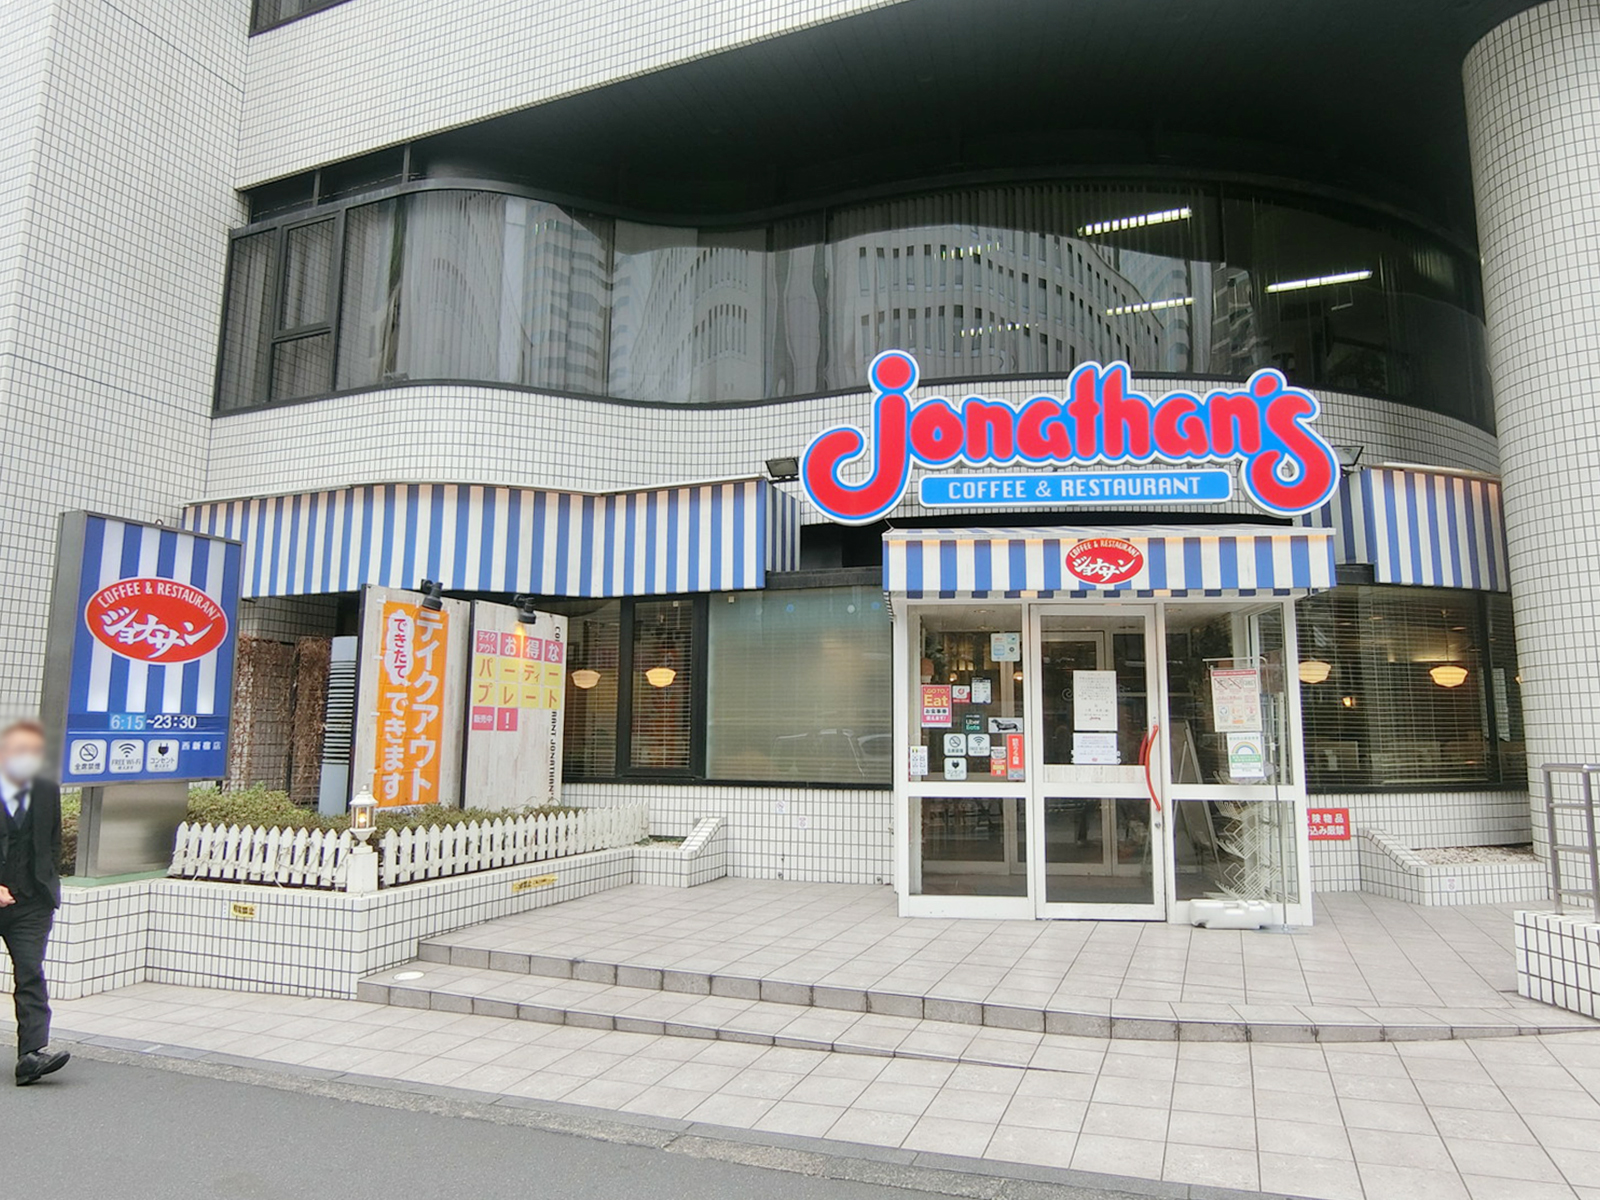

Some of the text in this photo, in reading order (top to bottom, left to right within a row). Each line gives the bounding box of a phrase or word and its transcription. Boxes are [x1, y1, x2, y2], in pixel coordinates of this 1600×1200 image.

[949, 476, 1201, 500] COFFEE & RESTAURANT
[1069, 539, 1140, 559] COFFEE & RESTAURANT
[1072, 555, 1136, 583] ジョナサン
[97, 581, 222, 621] COFFEE & RESTAURANT
[100, 606, 214, 659] ジョナサン
[393, 618, 408, 680] できたて
[478, 657, 559, 683] パーティー
[409, 611, 444, 802] テイクアウト
[478, 683, 558, 708] プレート
[923, 694, 949, 707] Eat
[382, 691, 409, 800] できます
